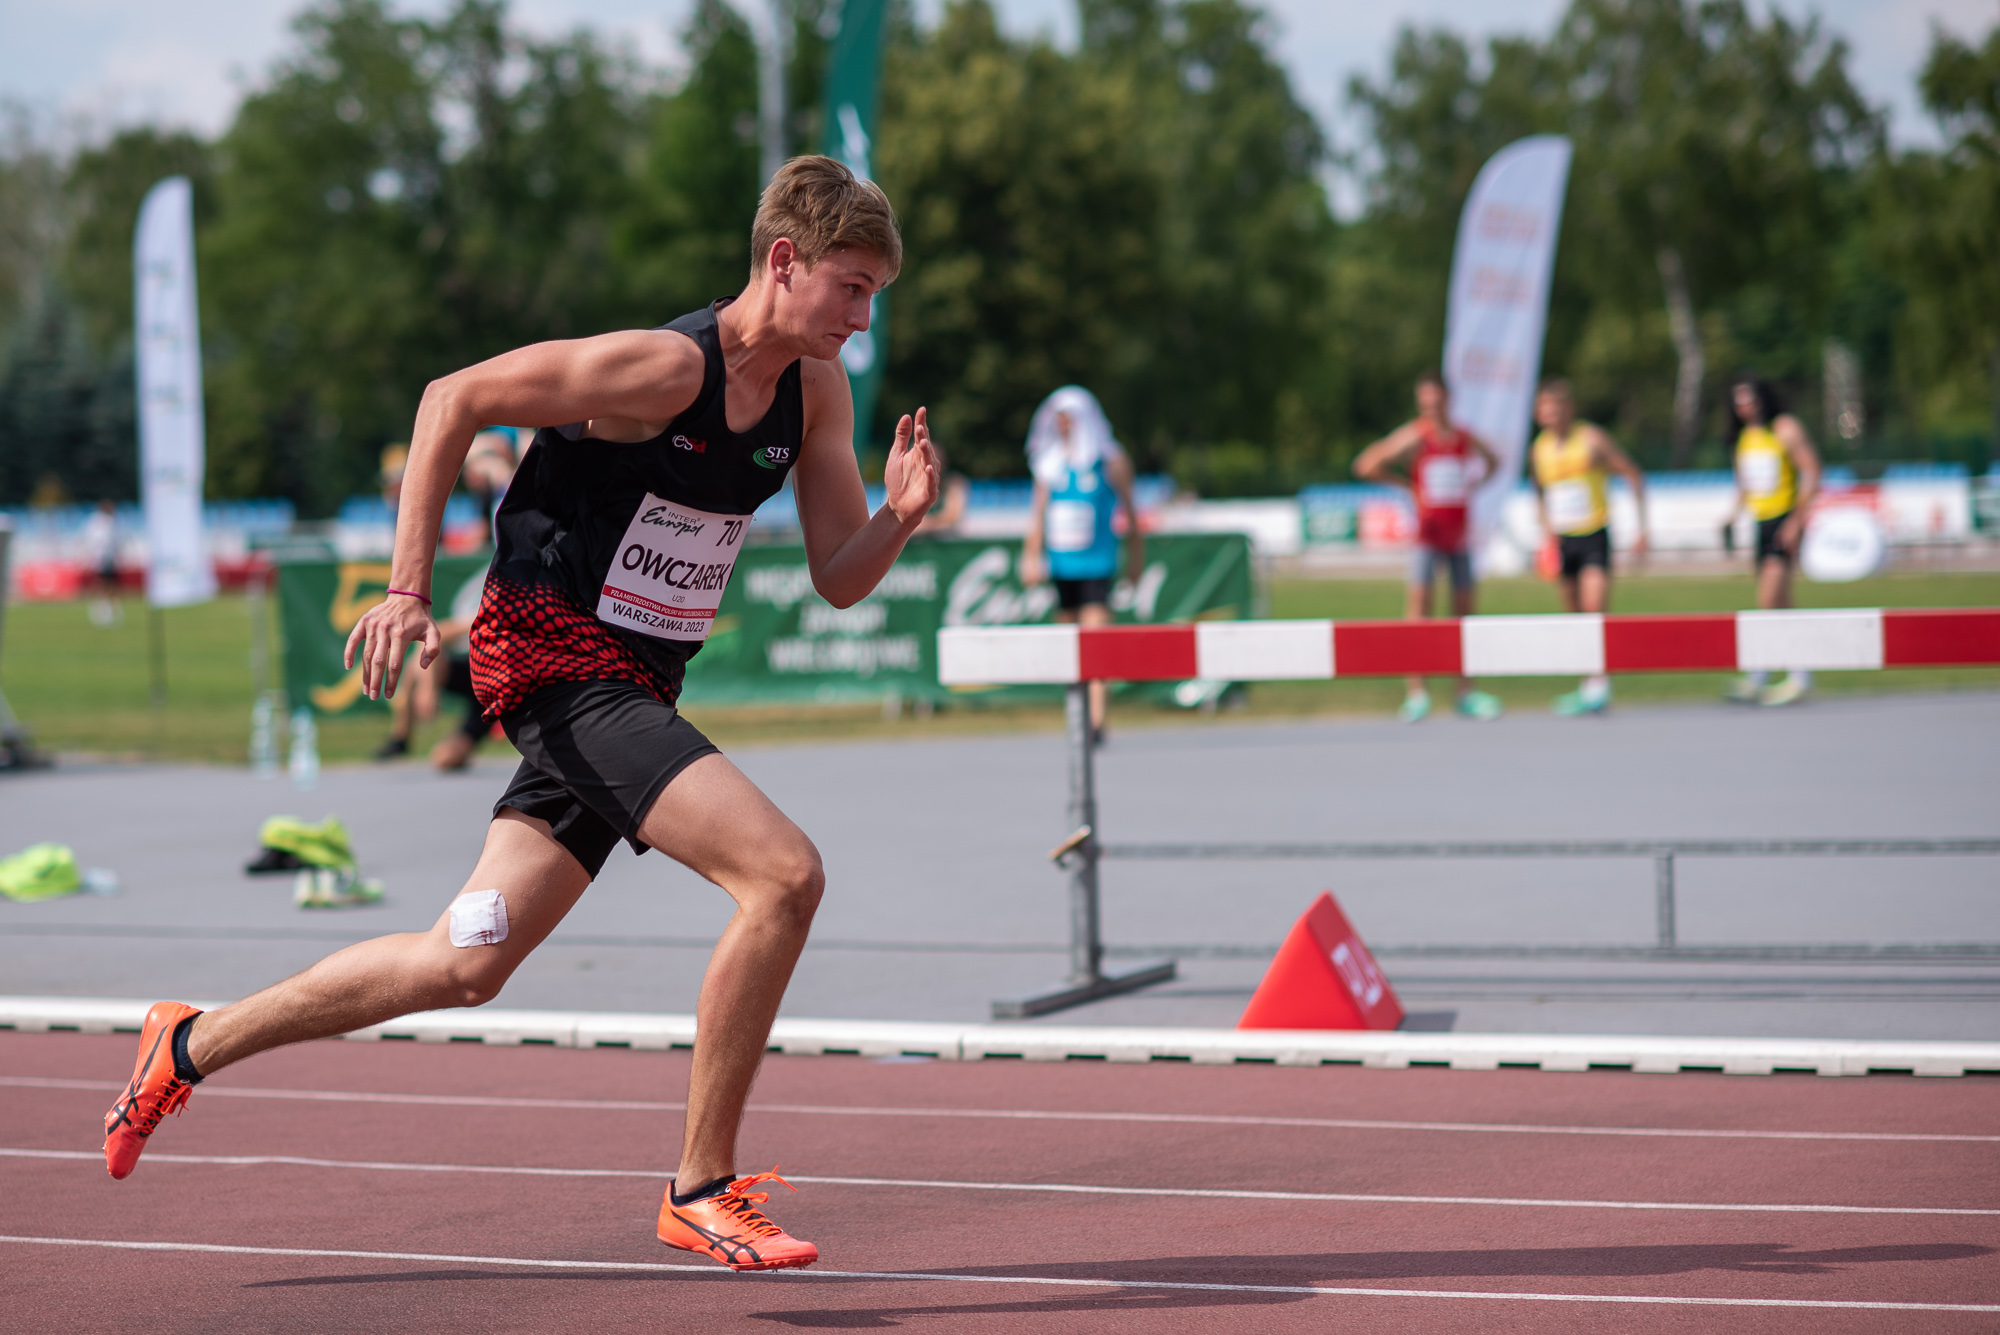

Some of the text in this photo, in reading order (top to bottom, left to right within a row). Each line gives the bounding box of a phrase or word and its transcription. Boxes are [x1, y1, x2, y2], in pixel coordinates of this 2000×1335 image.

[765, 446, 790, 459] STS
[641, 505, 705, 537] Europol
[668, 511, 697, 525] INTER
[715, 520, 743, 546] 70
[621, 543, 731, 590] OWCZAREK
[611, 589, 622, 598] PZLA
[623, 593, 661, 611] MISTRZOSTWA
[672, 595, 685, 604] U20
[613, 602, 704, 632] WARSZAWA 2023
